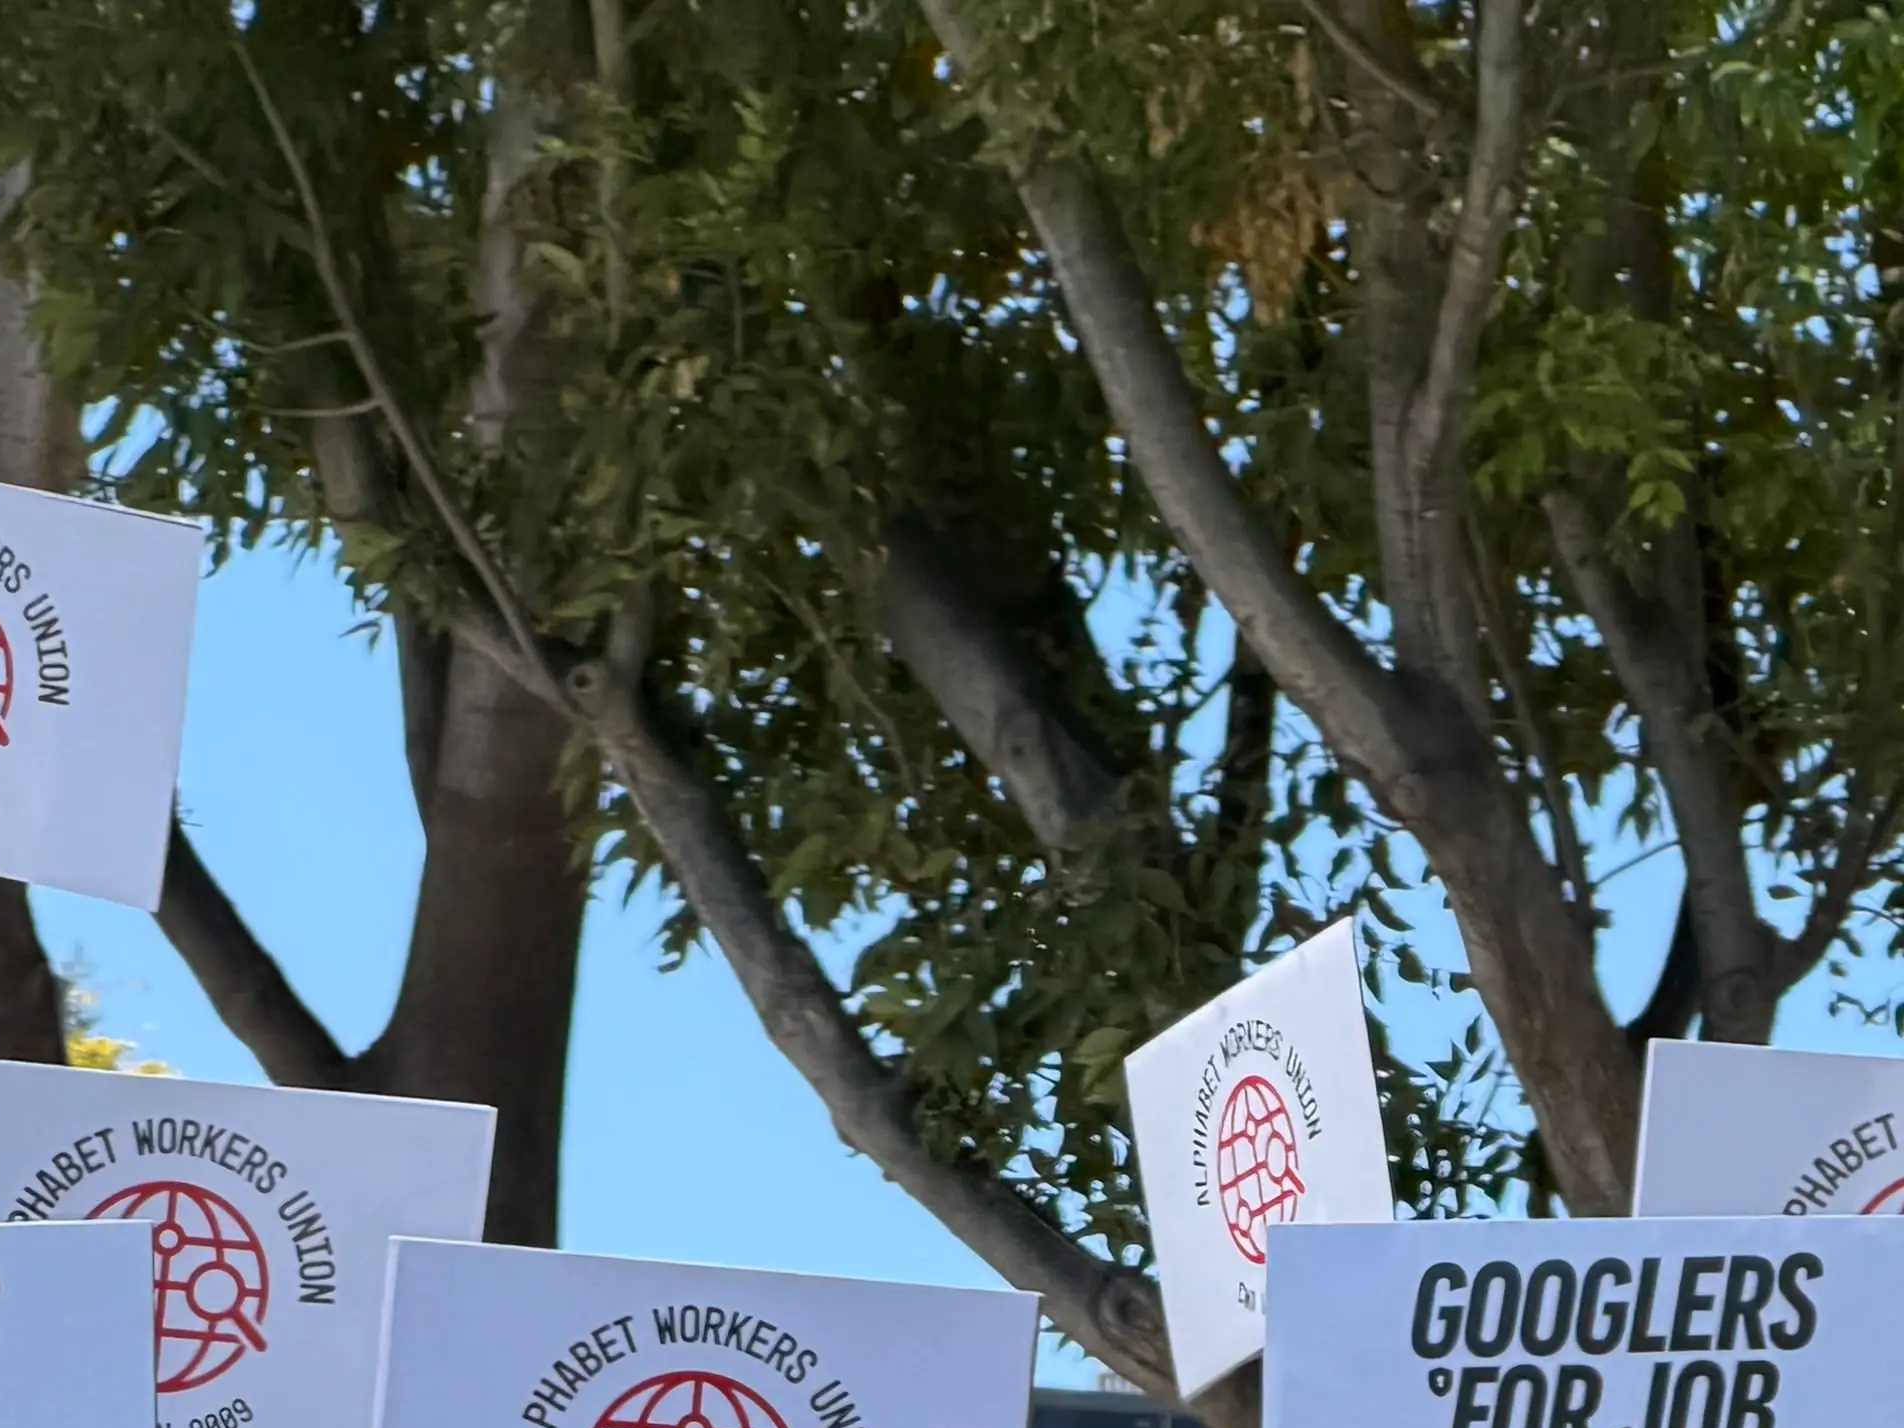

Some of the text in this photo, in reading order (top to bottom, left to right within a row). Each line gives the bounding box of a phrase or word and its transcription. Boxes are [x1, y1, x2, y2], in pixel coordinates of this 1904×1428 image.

[23, 592, 71, 706] UNION
[1219, 1019, 1283, 1068] WORKERS
[1286, 1045, 1322, 1140] UNION
[7, 1117, 336, 1305] HABET WORKERS UNION
[1782, 1112, 1898, 1215] PHABET
[653, 1304, 819, 1385] WORKERS
[1411, 1253, 1823, 1359] GOOGLERS
